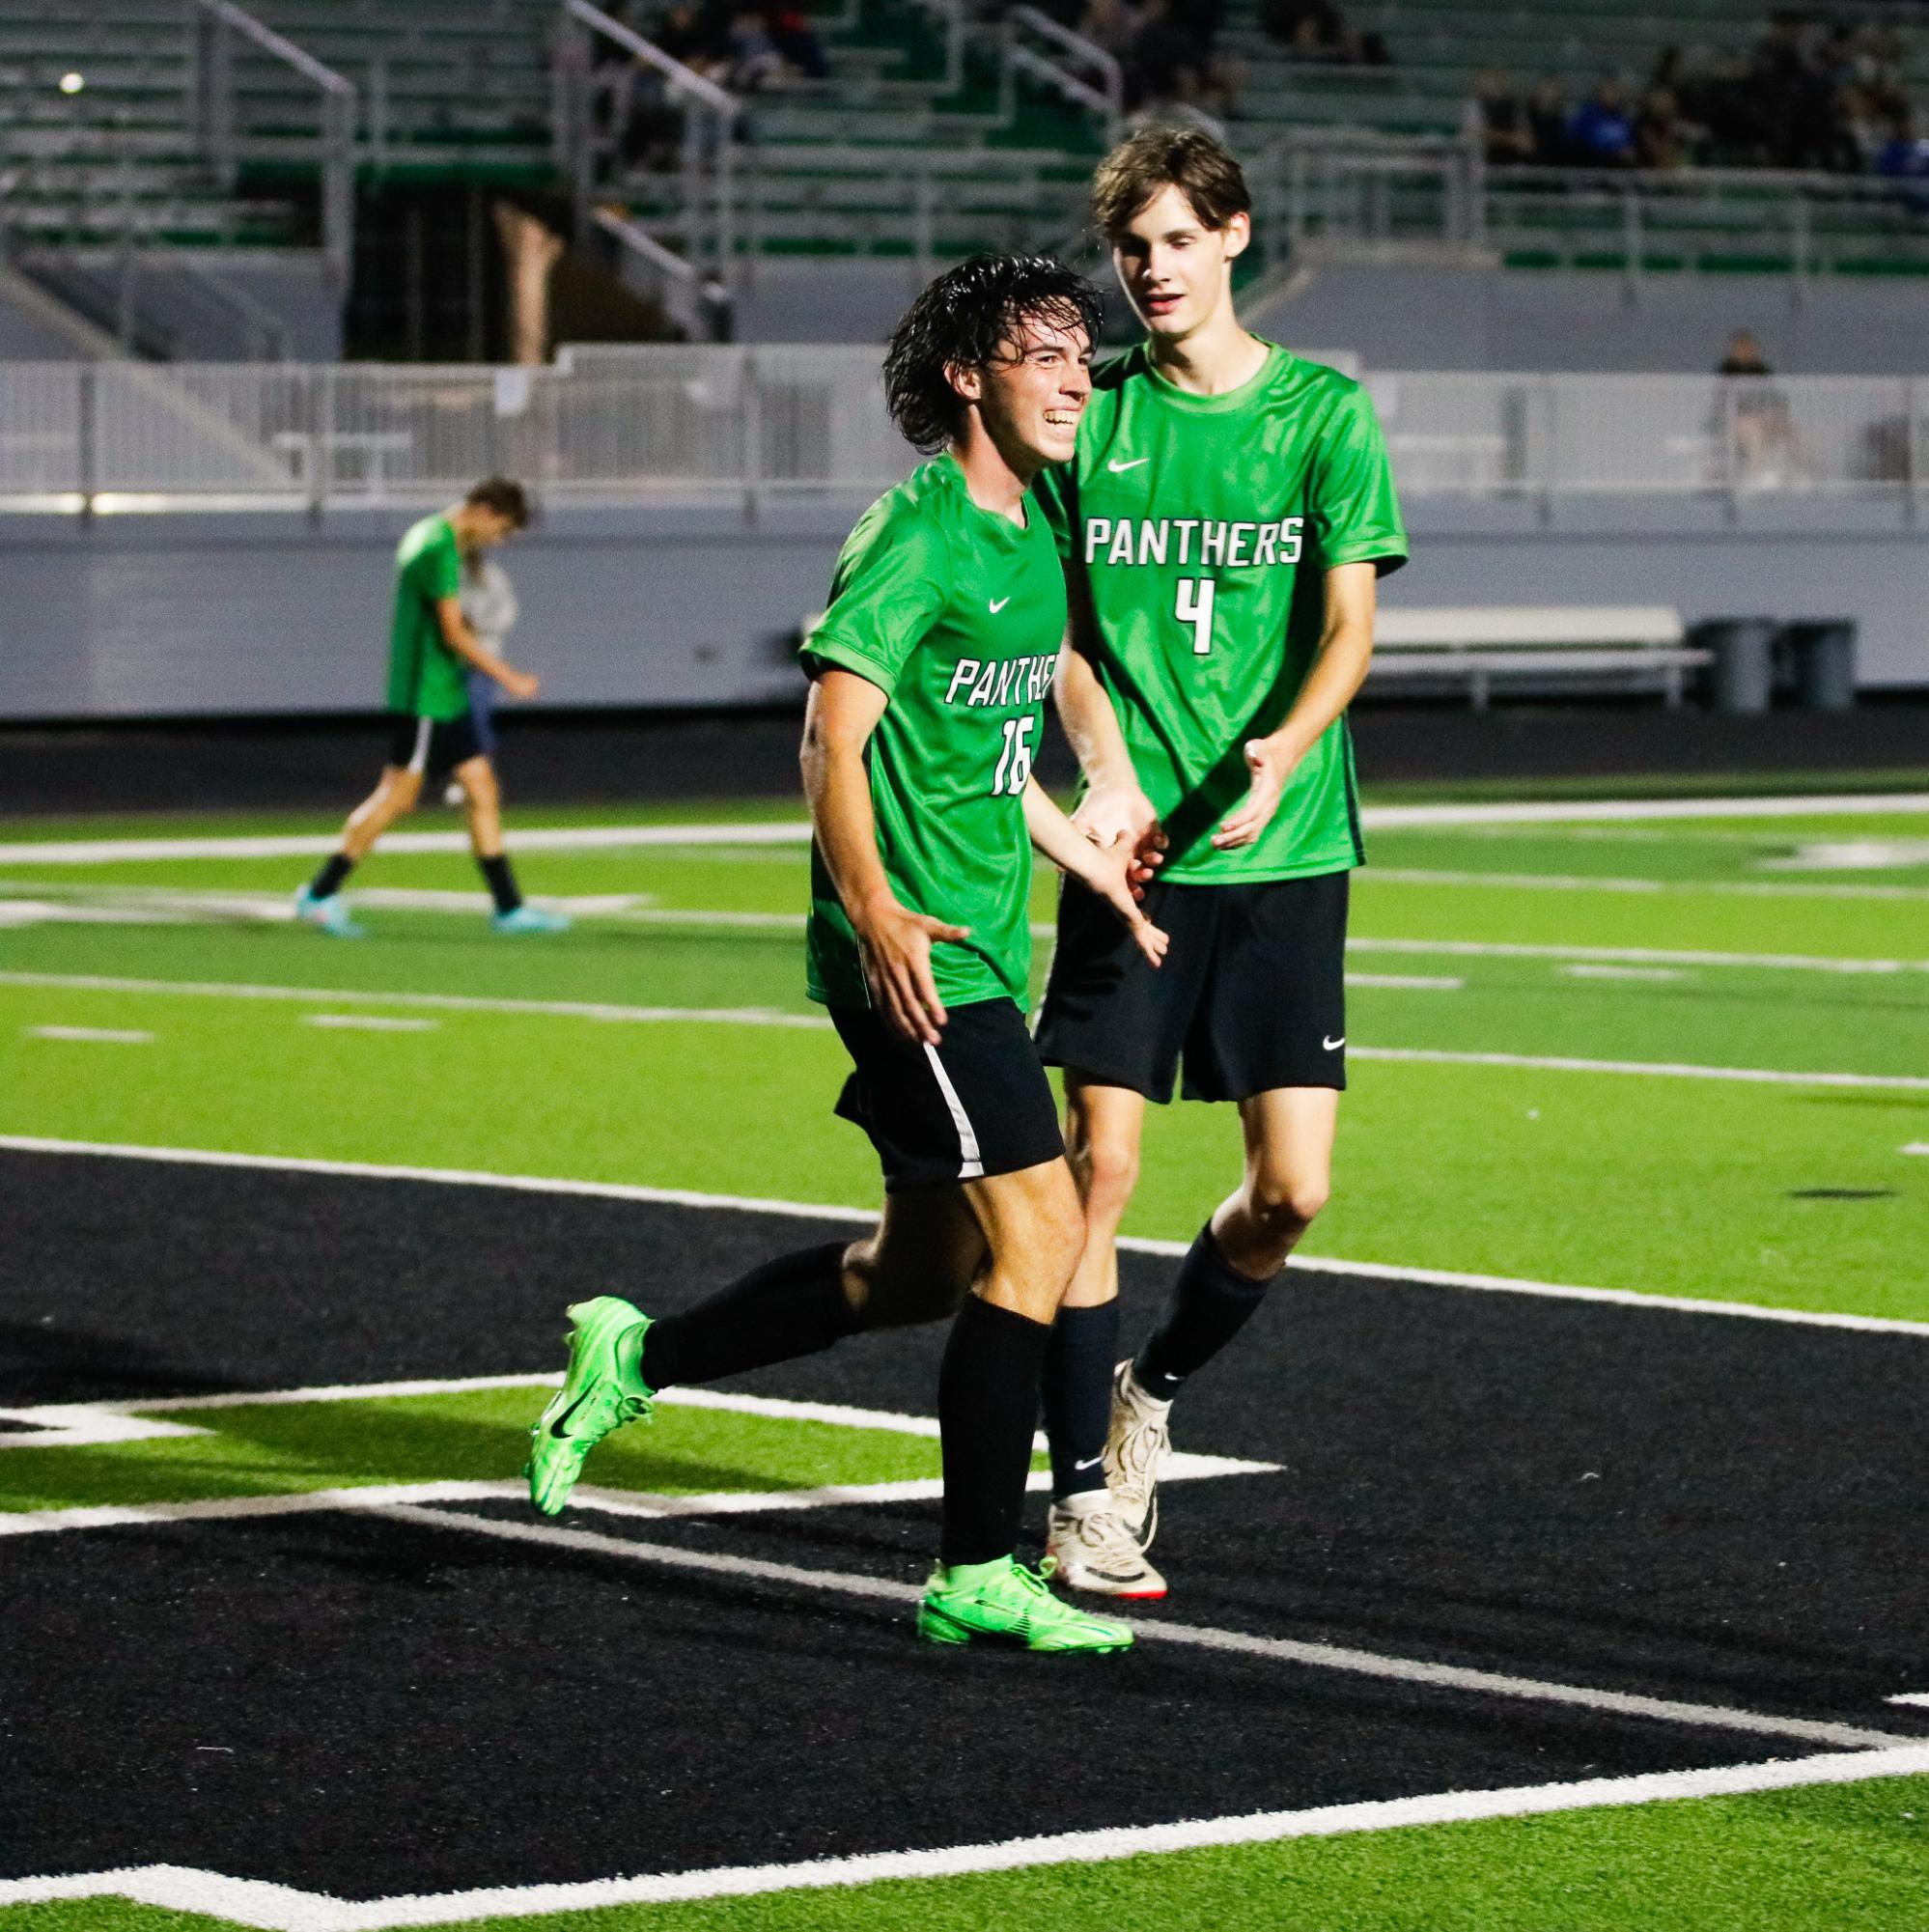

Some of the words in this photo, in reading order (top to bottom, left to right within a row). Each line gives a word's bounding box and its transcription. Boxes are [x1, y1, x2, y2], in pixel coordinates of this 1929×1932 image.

[1084, 517, 1305, 568] PANTHERS
[1174, 577, 1216, 655] 4
[944, 654, 1057, 707] PANTHE
[991, 714, 1035, 797] 16
